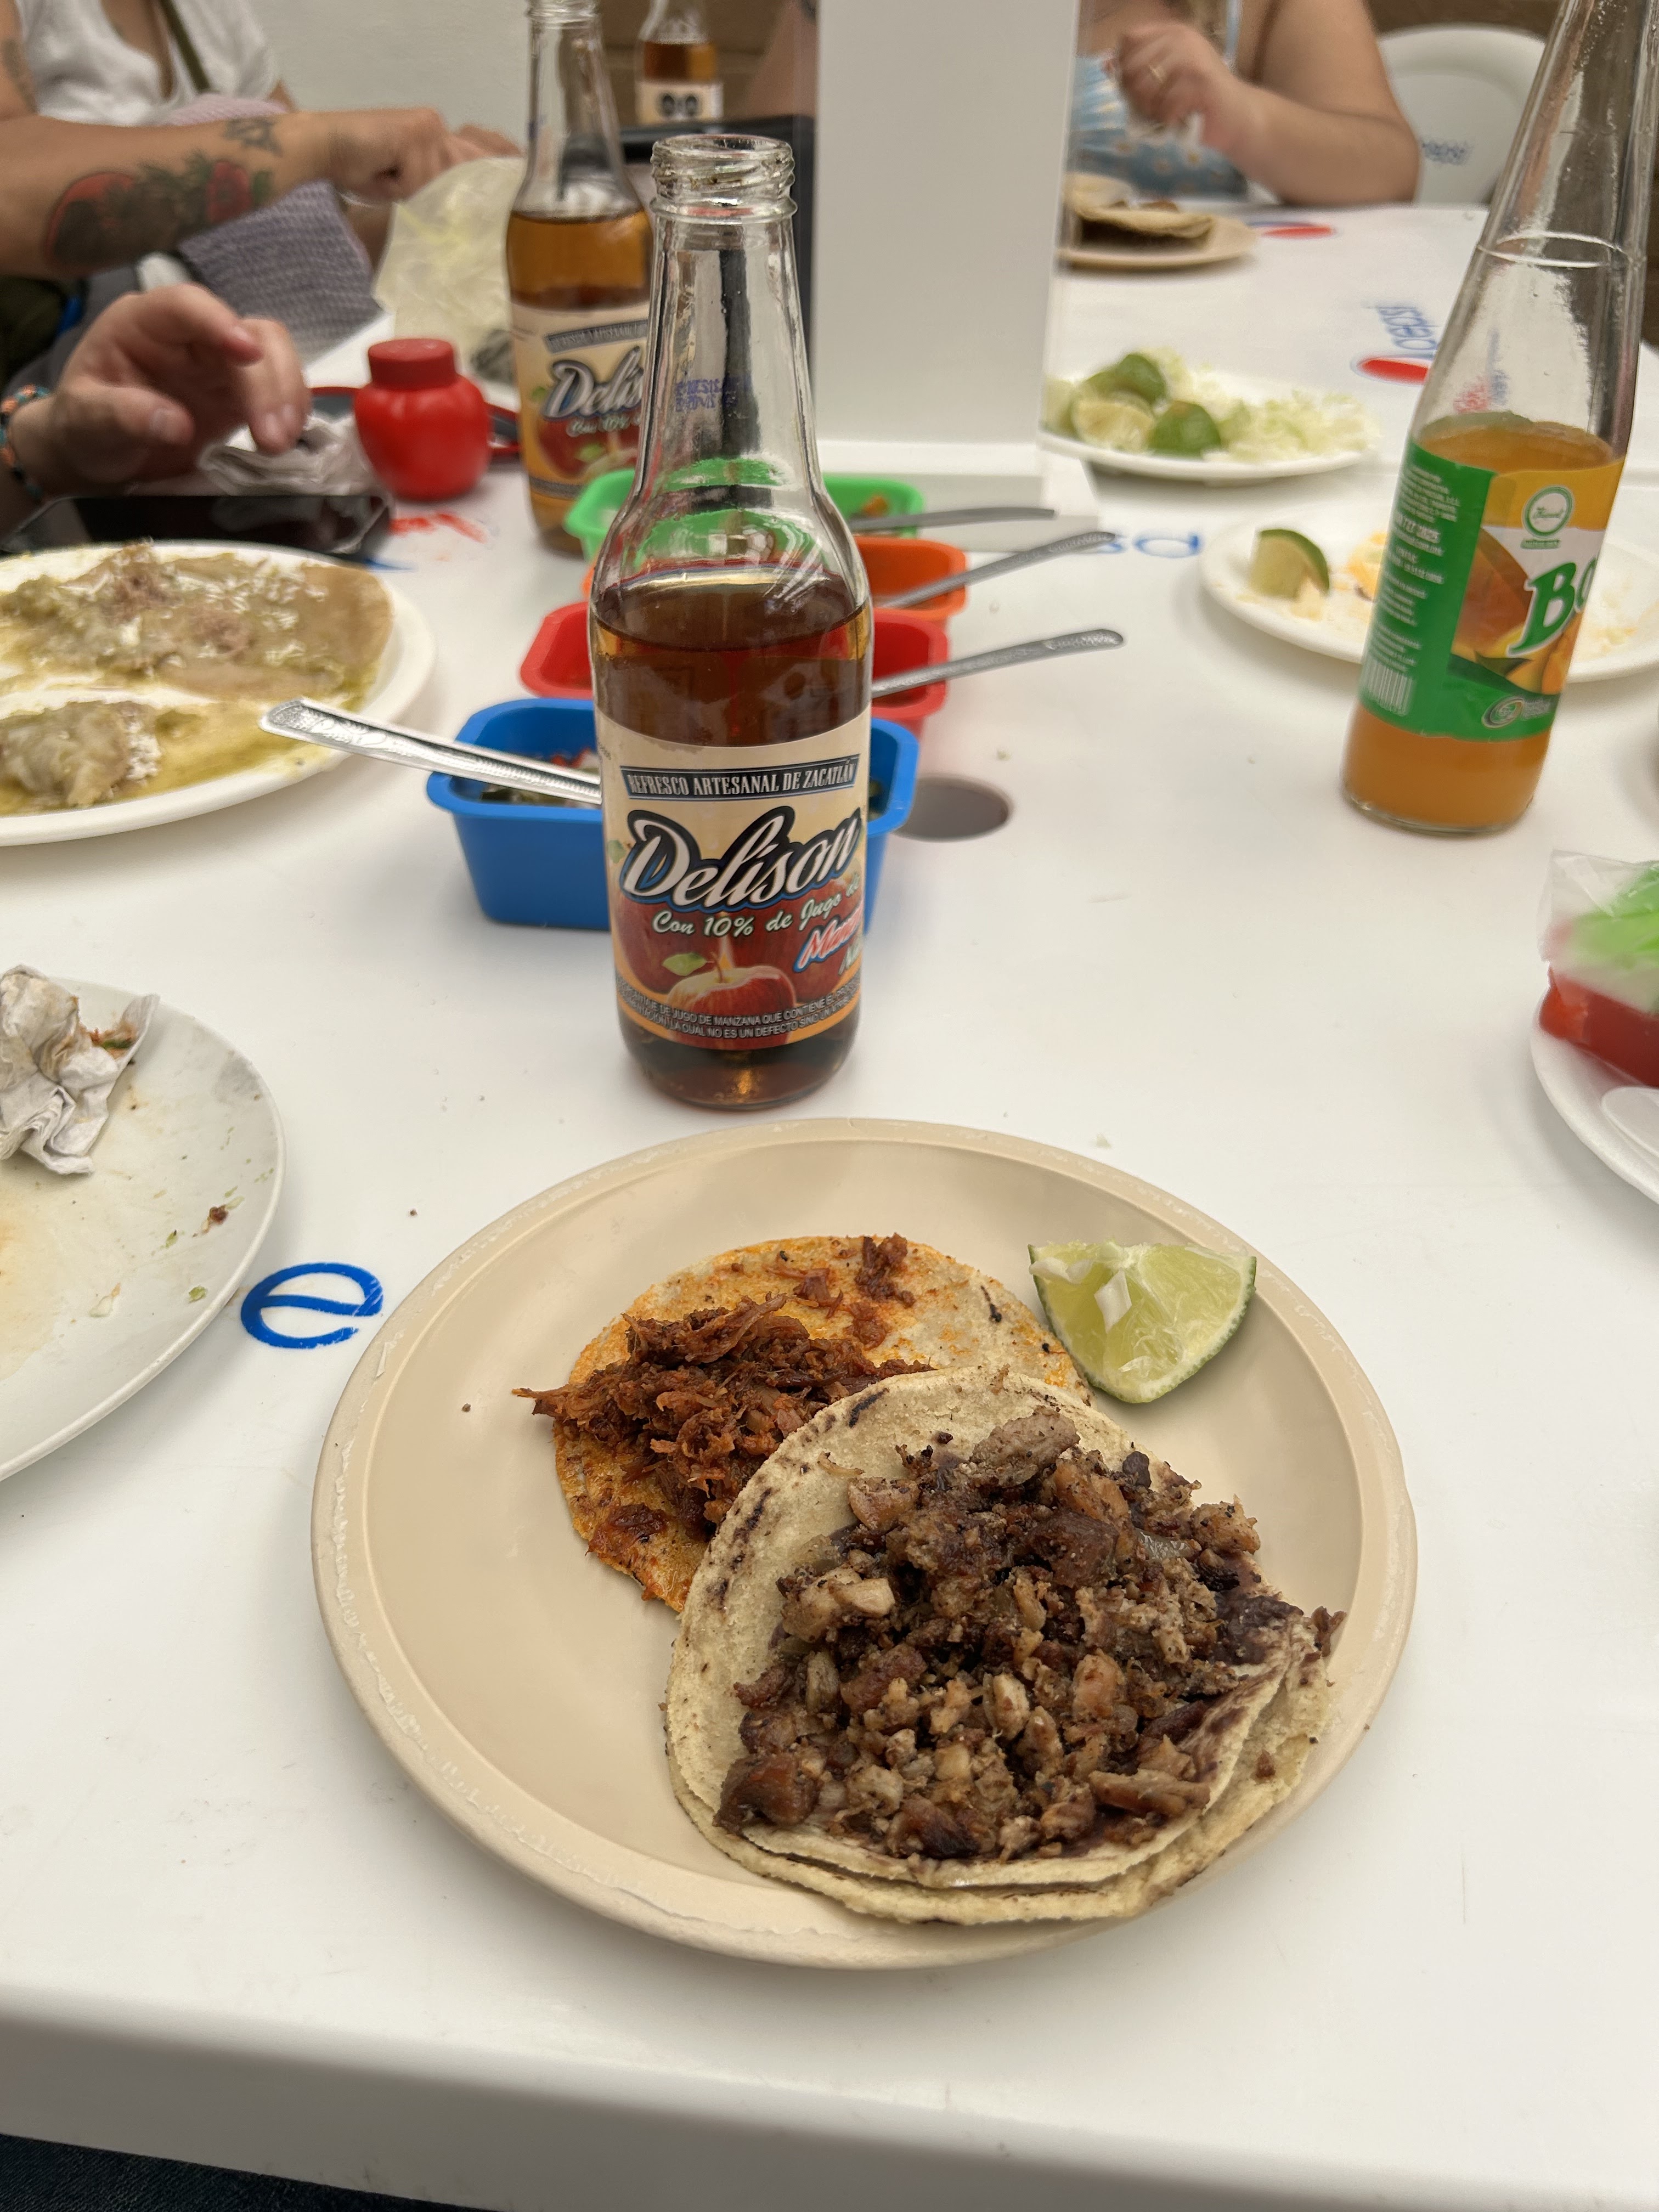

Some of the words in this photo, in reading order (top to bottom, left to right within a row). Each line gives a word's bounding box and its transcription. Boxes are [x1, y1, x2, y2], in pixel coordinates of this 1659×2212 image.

[627, 774, 690, 795] REFRESCO
[693, 774, 780, 795] ARTESANAL
[782, 772, 801, 791] DE
[621, 806, 862, 912] Delison
[652, 909, 694, 935] Con
[703, 916, 754, 936] 10%
[765, 910, 793, 932] de
[798, 891, 842, 932] Jugo
[698, 1015, 713, 1025] DE
[713, 1015, 761, 1026] MANZANA
[761, 1012, 783, 1024] QUE
[723, 1028, 737, 1039] ES
[754, 1021, 799, 1037] DEFECTO
